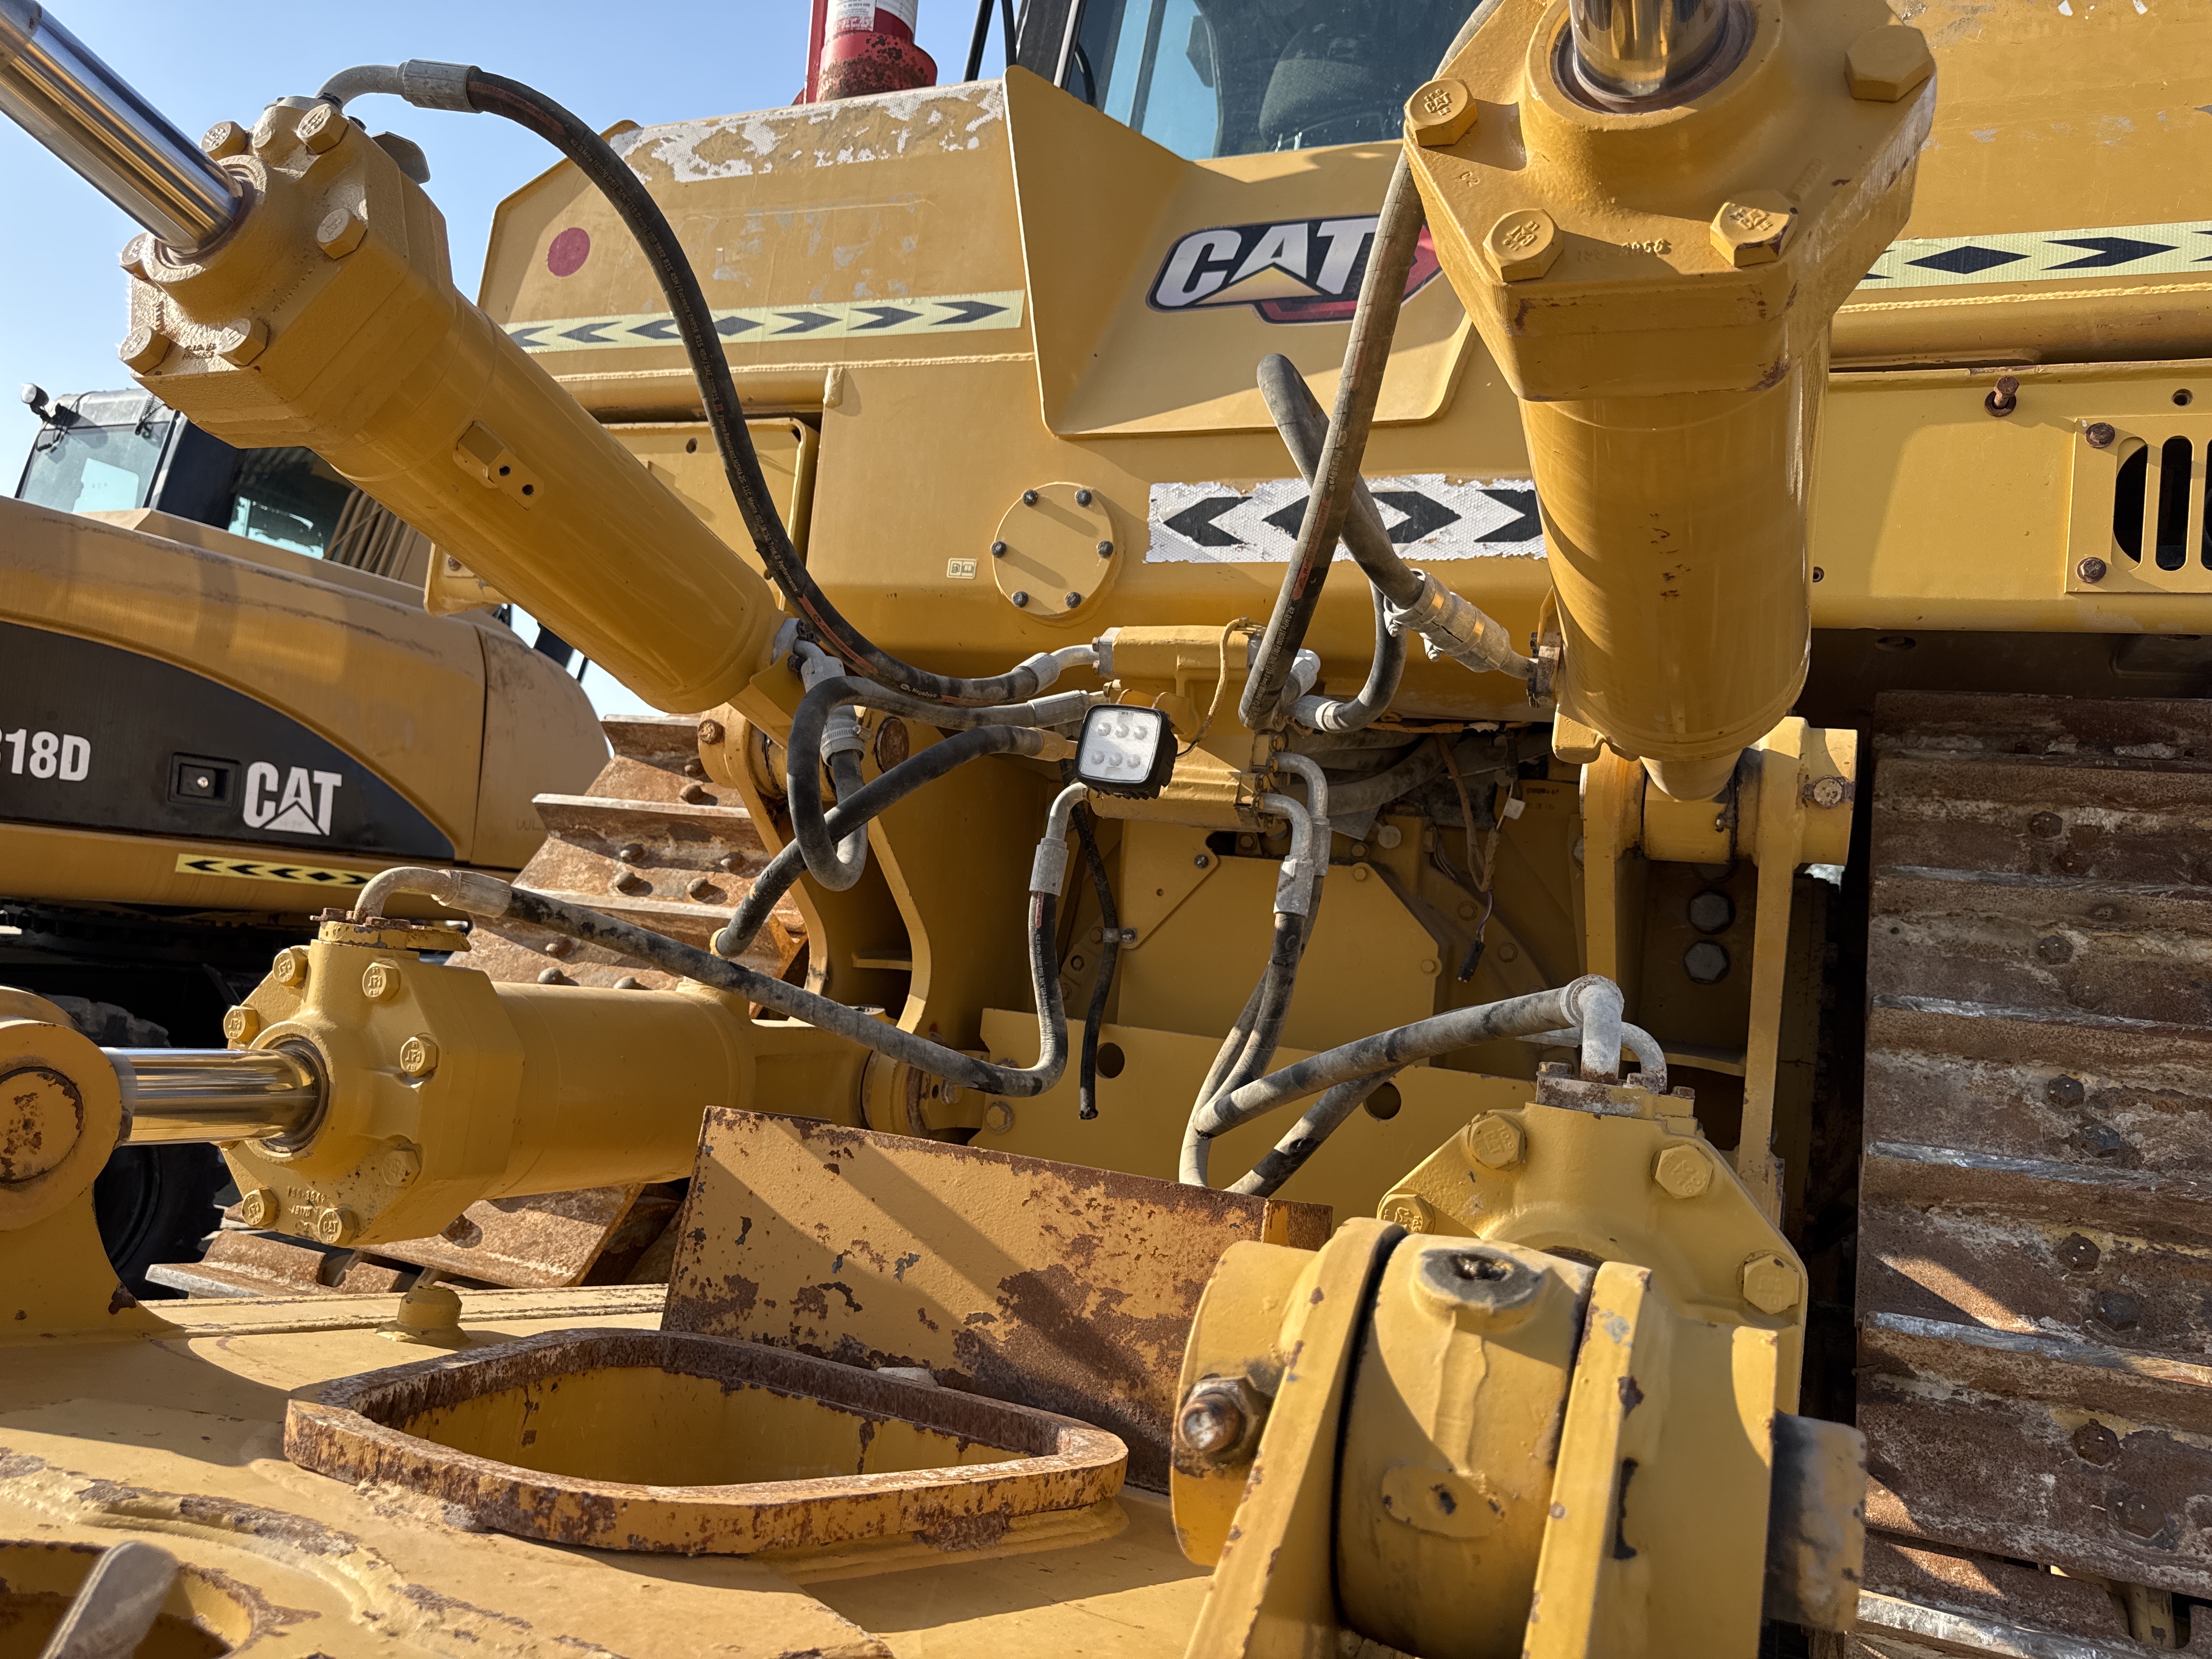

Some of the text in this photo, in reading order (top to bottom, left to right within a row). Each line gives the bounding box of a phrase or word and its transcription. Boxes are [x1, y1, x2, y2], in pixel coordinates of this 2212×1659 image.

[648, 232, 658, 242] ISO
[663, 259, 674, 272] R15
[1155, 218, 1379, 307] CAT
[0, 728, 91, 782] 18D
[242, 761, 343, 837] CAT
